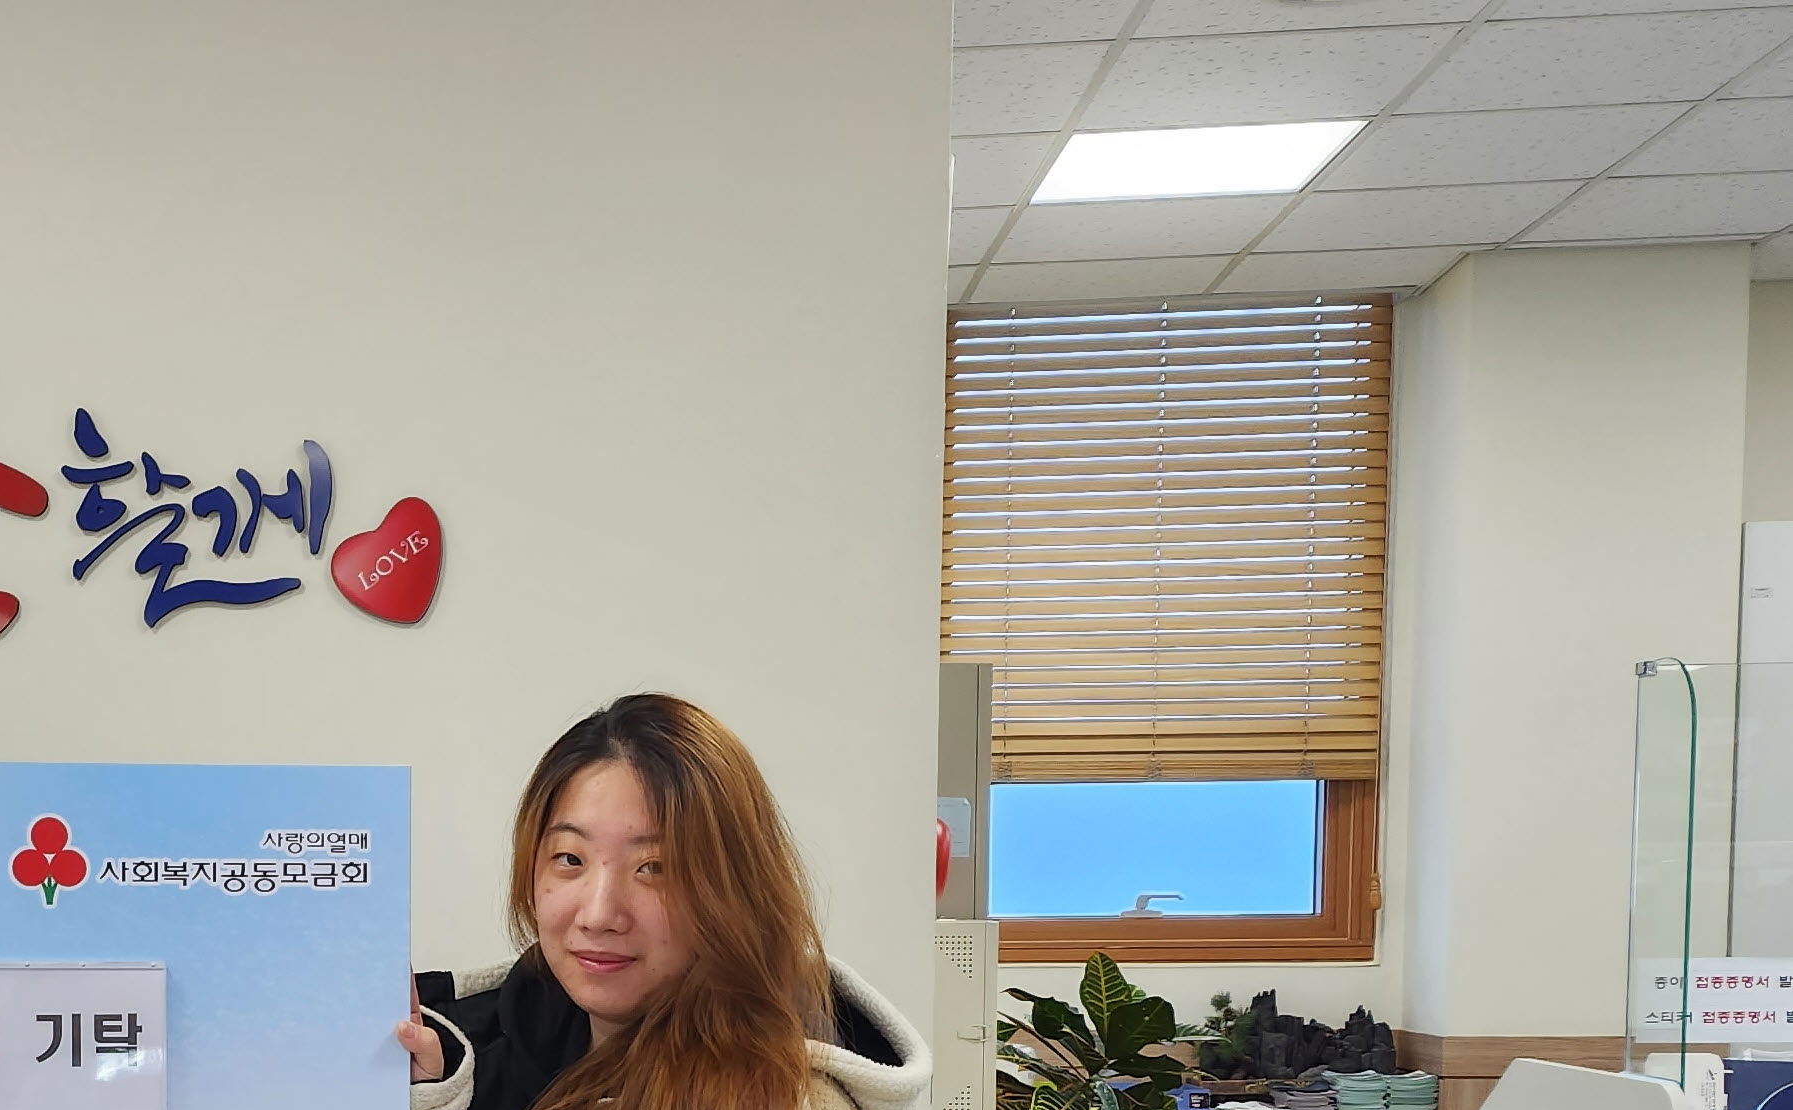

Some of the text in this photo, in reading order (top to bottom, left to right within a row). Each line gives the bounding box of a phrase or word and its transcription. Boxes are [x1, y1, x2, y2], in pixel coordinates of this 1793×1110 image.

[357, 530, 429, 590] LOVE
[262, 831, 368, 854] 사랑의열매
[99, 860, 368, 893] 사회복지공동모금회
[1645, 1011, 1693, 1024] 스티커
[35, 1012, 143, 1068] 기탁
